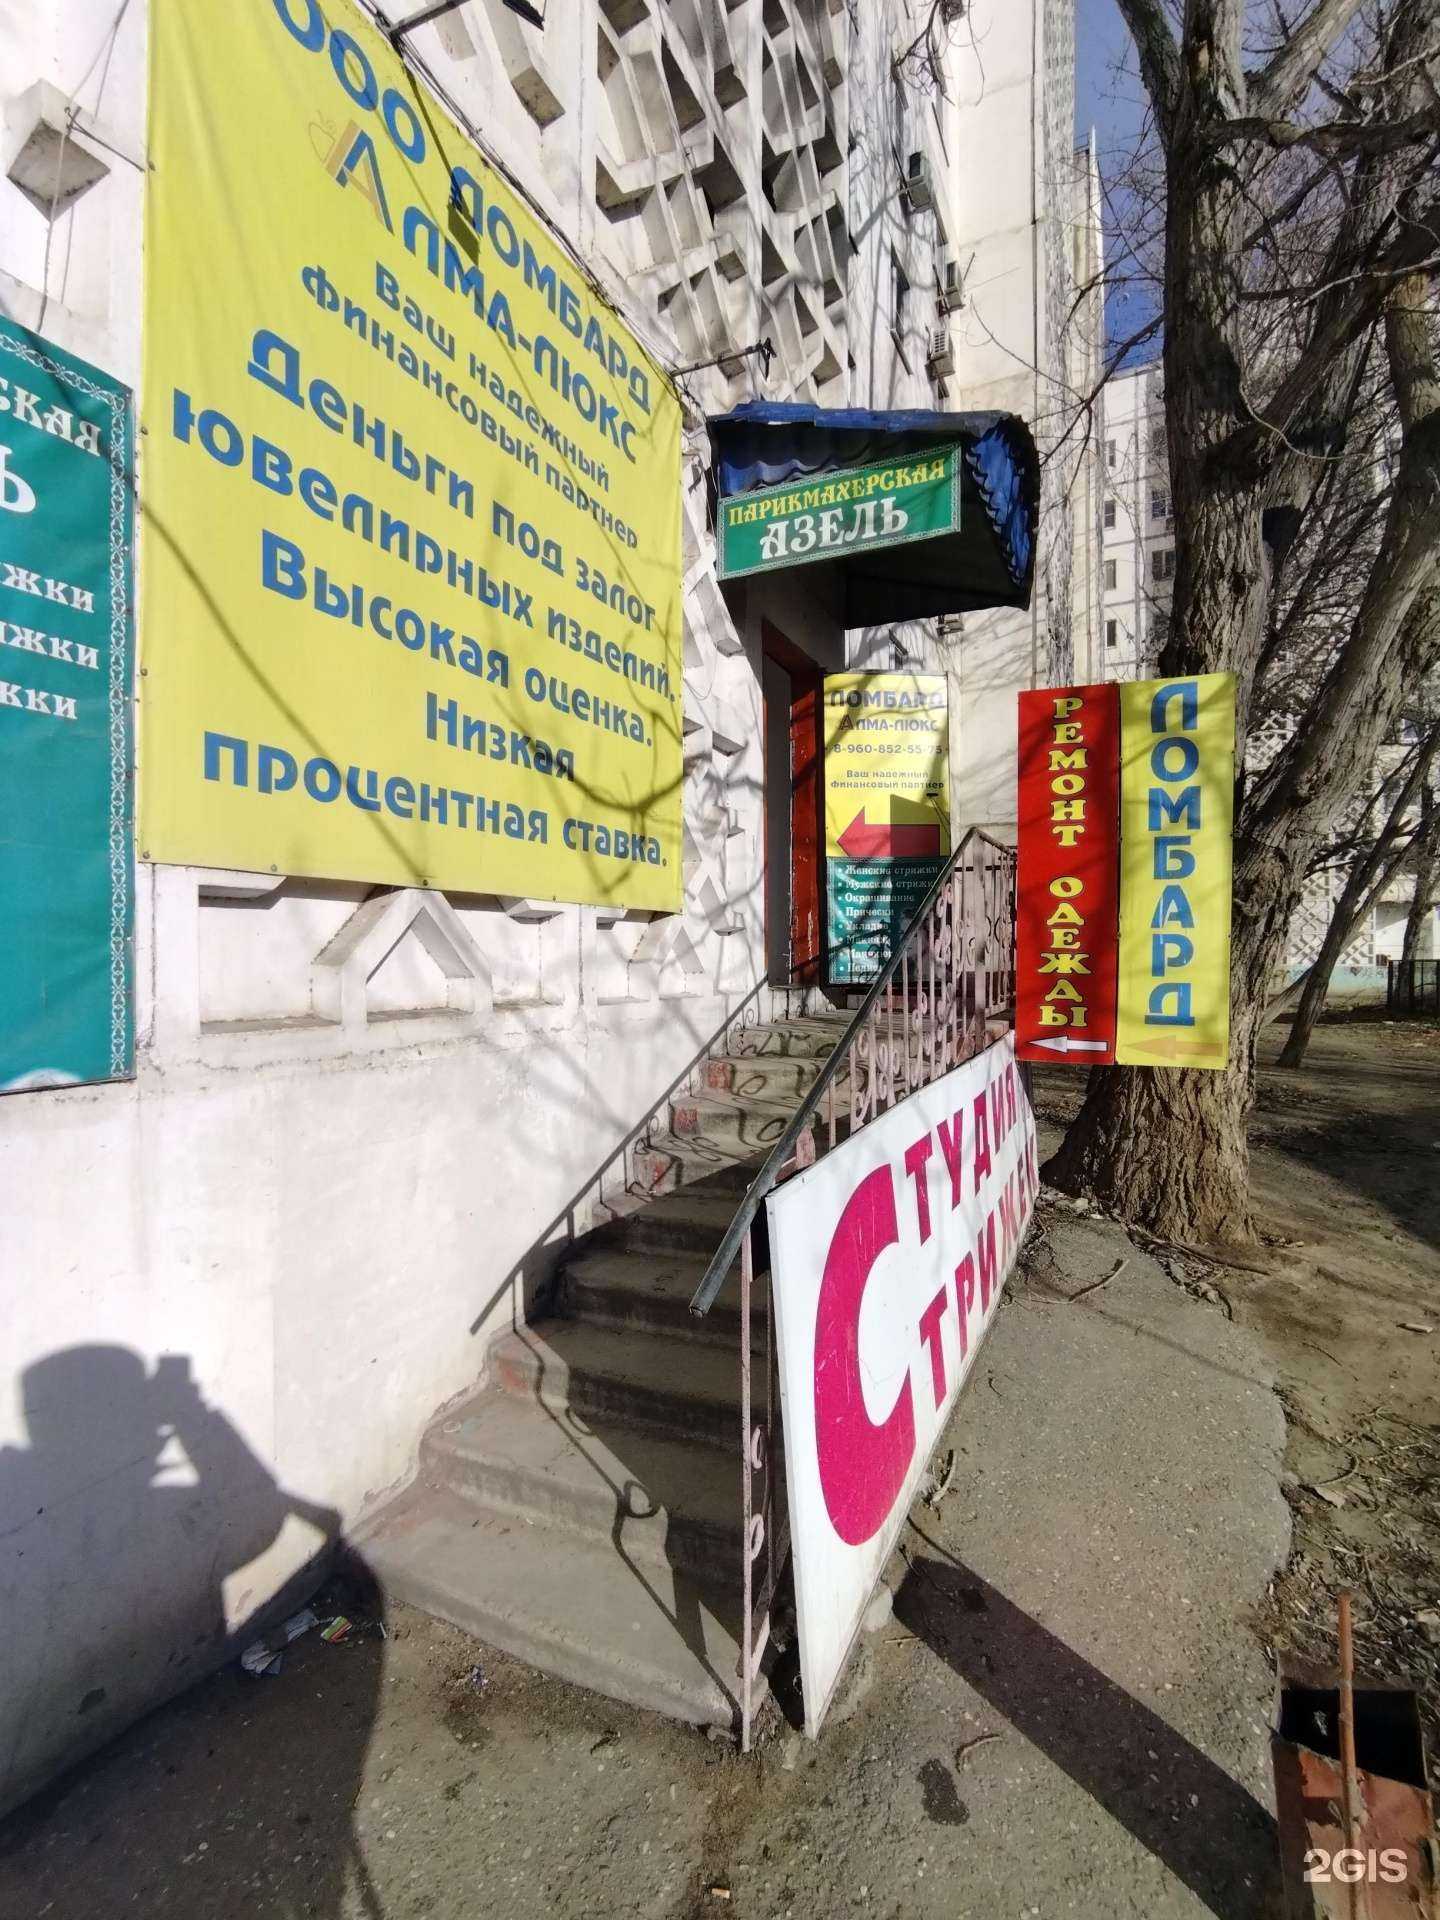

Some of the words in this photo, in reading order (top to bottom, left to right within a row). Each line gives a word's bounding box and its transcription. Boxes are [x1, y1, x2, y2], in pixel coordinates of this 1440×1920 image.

[273, 0, 426, 164] ООО
[450, 166, 651, 416] ЛОМБАРД
[302, 265, 539, 475] финансовый
[546, 462, 638, 549] партнер
[376, 261, 456, 361] Ваш
[469, 352, 609, 492] надежный
[247, 329, 474, 519] Деньги
[492, 500, 564, 577] под
[576, 557, 656, 632] залог
[728, 460, 946, 527] ПАРИКМАХЕРСКАЯ
[760, 497, 909, 560] АЗЕЛЬ
[262, 528, 509, 689] Высокая
[525, 667, 652, 747] оценка.
[548, 606, 676, 702] изделий.
[830, 689, 944, 708] ЛОМБАРД
[204, 730, 548, 844] процентная
[563, 818, 667, 866] ставка.
[426, 691, 575, 782] Низкая
[846, 769, 869, 778] Ваш
[1048, 697, 1088, 847] РЕМОНТ
[1144, 681, 1201, 1027] ЛОМБАРД
[1038, 876, 1091, 1027] ОДЕЖДЫ
